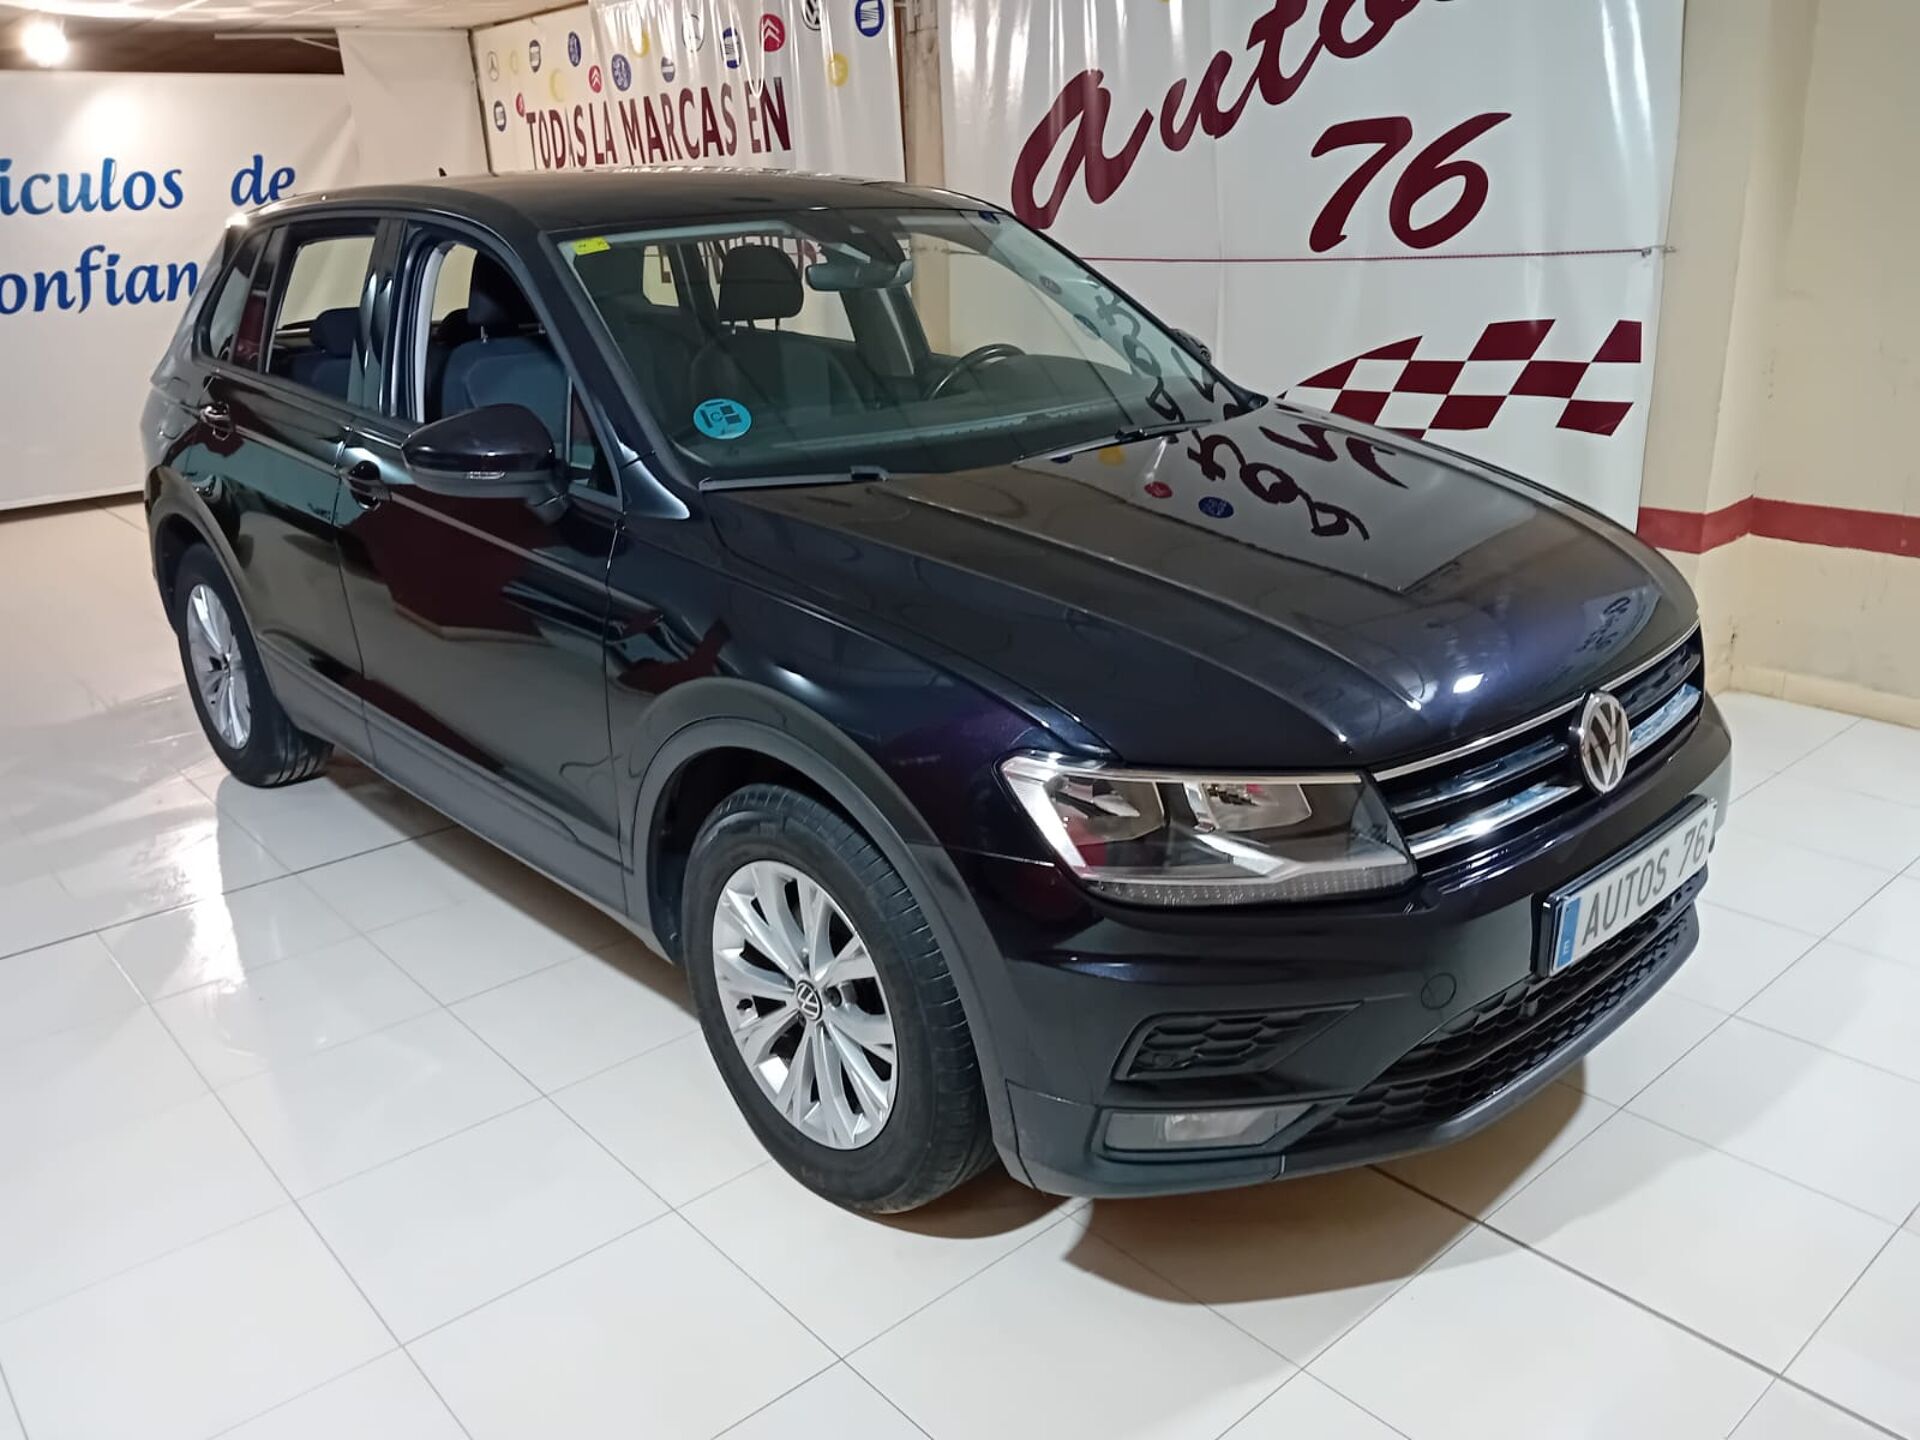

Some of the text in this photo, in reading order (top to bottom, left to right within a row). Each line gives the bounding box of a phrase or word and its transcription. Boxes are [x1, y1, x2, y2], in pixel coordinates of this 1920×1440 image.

[526, 77, 791, 170] TODAS LA MARCAS EN
[231, 154, 295, 206] de
[1309, 112, 1512, 253] 76
[1582, 818, 1708, 946] AUTOS 76
